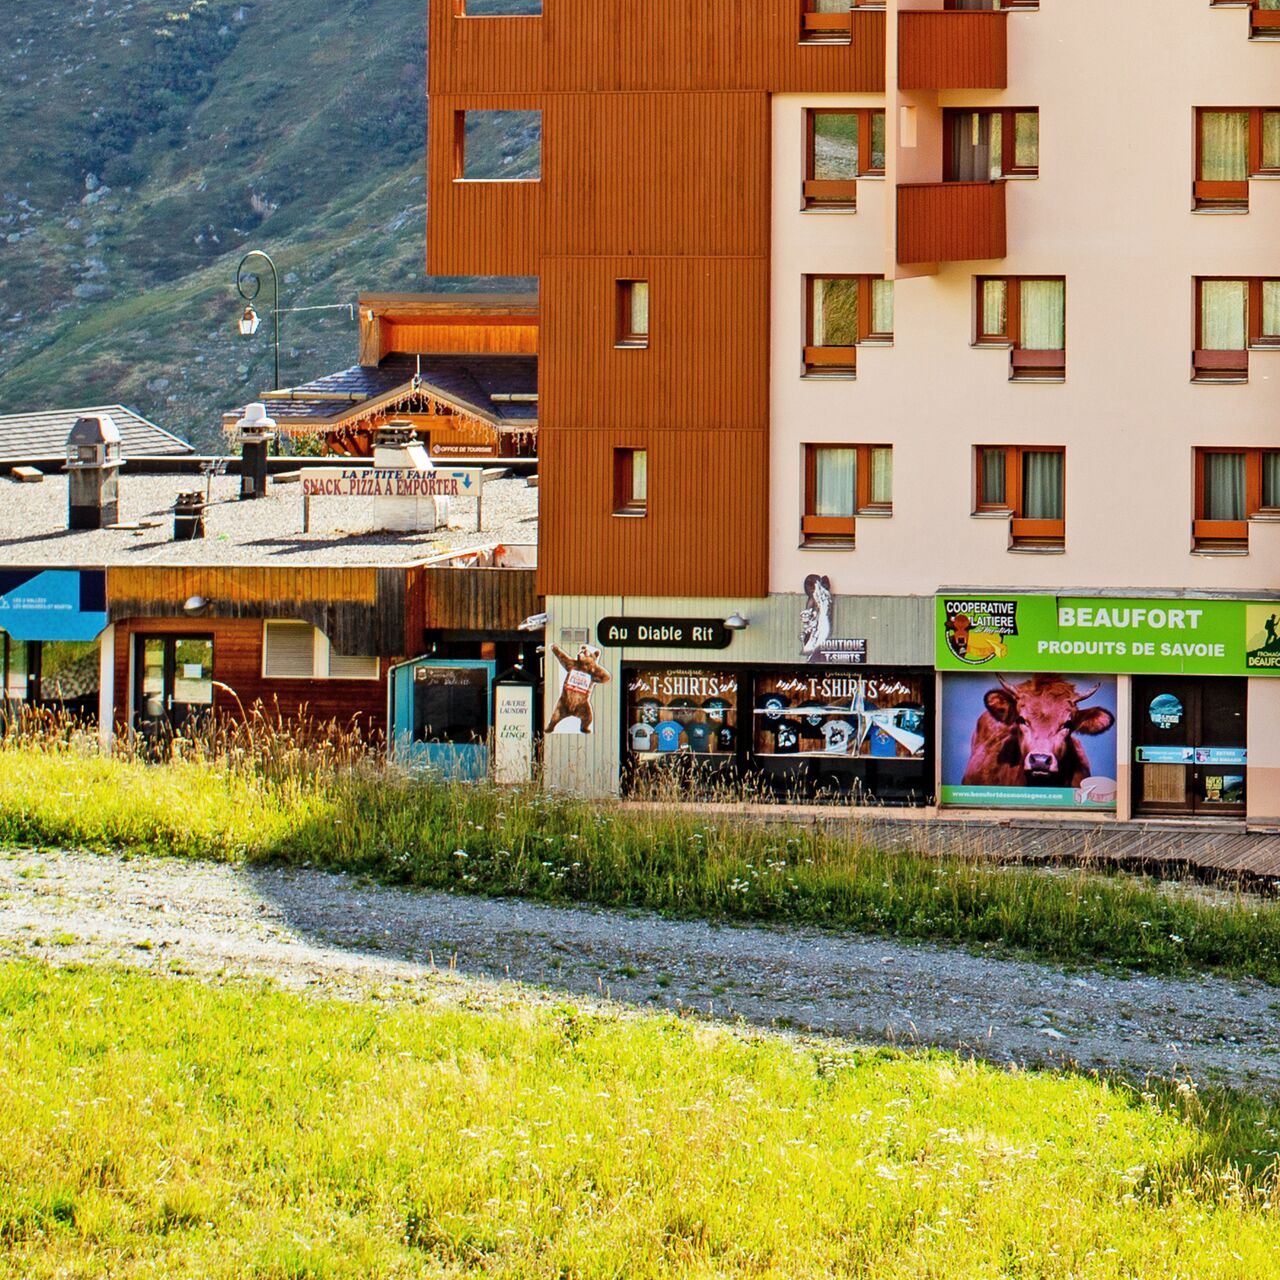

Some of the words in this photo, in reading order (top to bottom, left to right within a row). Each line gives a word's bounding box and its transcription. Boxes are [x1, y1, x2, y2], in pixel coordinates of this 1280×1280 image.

[342, 470, 357, 479] LA
[362, 470, 402, 479] P'TITE
[407, 470, 437, 479] FAIM
[303, 478, 342, 496] SNACK
[349, 478, 381, 496] PIZZA
[396, 478, 459, 496] EMPORTER
[946, 601, 1015, 615] COOPERATIVE
[970, 616, 1014, 627] LAITIERE
[1058, 607, 1203, 630] BEAUFORT
[608, 625, 628, 640] Au
[638, 626, 683, 641] Diable
[692, 626, 714, 641] Rit
[821, 639, 865, 651] BOUTIQUE
[1037, 640, 1127, 656] PRODUITS
[1132, 642, 1155, 656] DE
[1160, 643, 1225, 657] SAVOIE
[825, 653, 861, 662] T-SHIRTS
[650, 676, 719, 696] T-SHIRTS
[808, 678, 878, 699] T-SHIRTS
[501, 699, 526, 707] LAVERIE
[500, 707, 528, 715] LAUNDRY
[500, 731, 528, 740] LINGE
